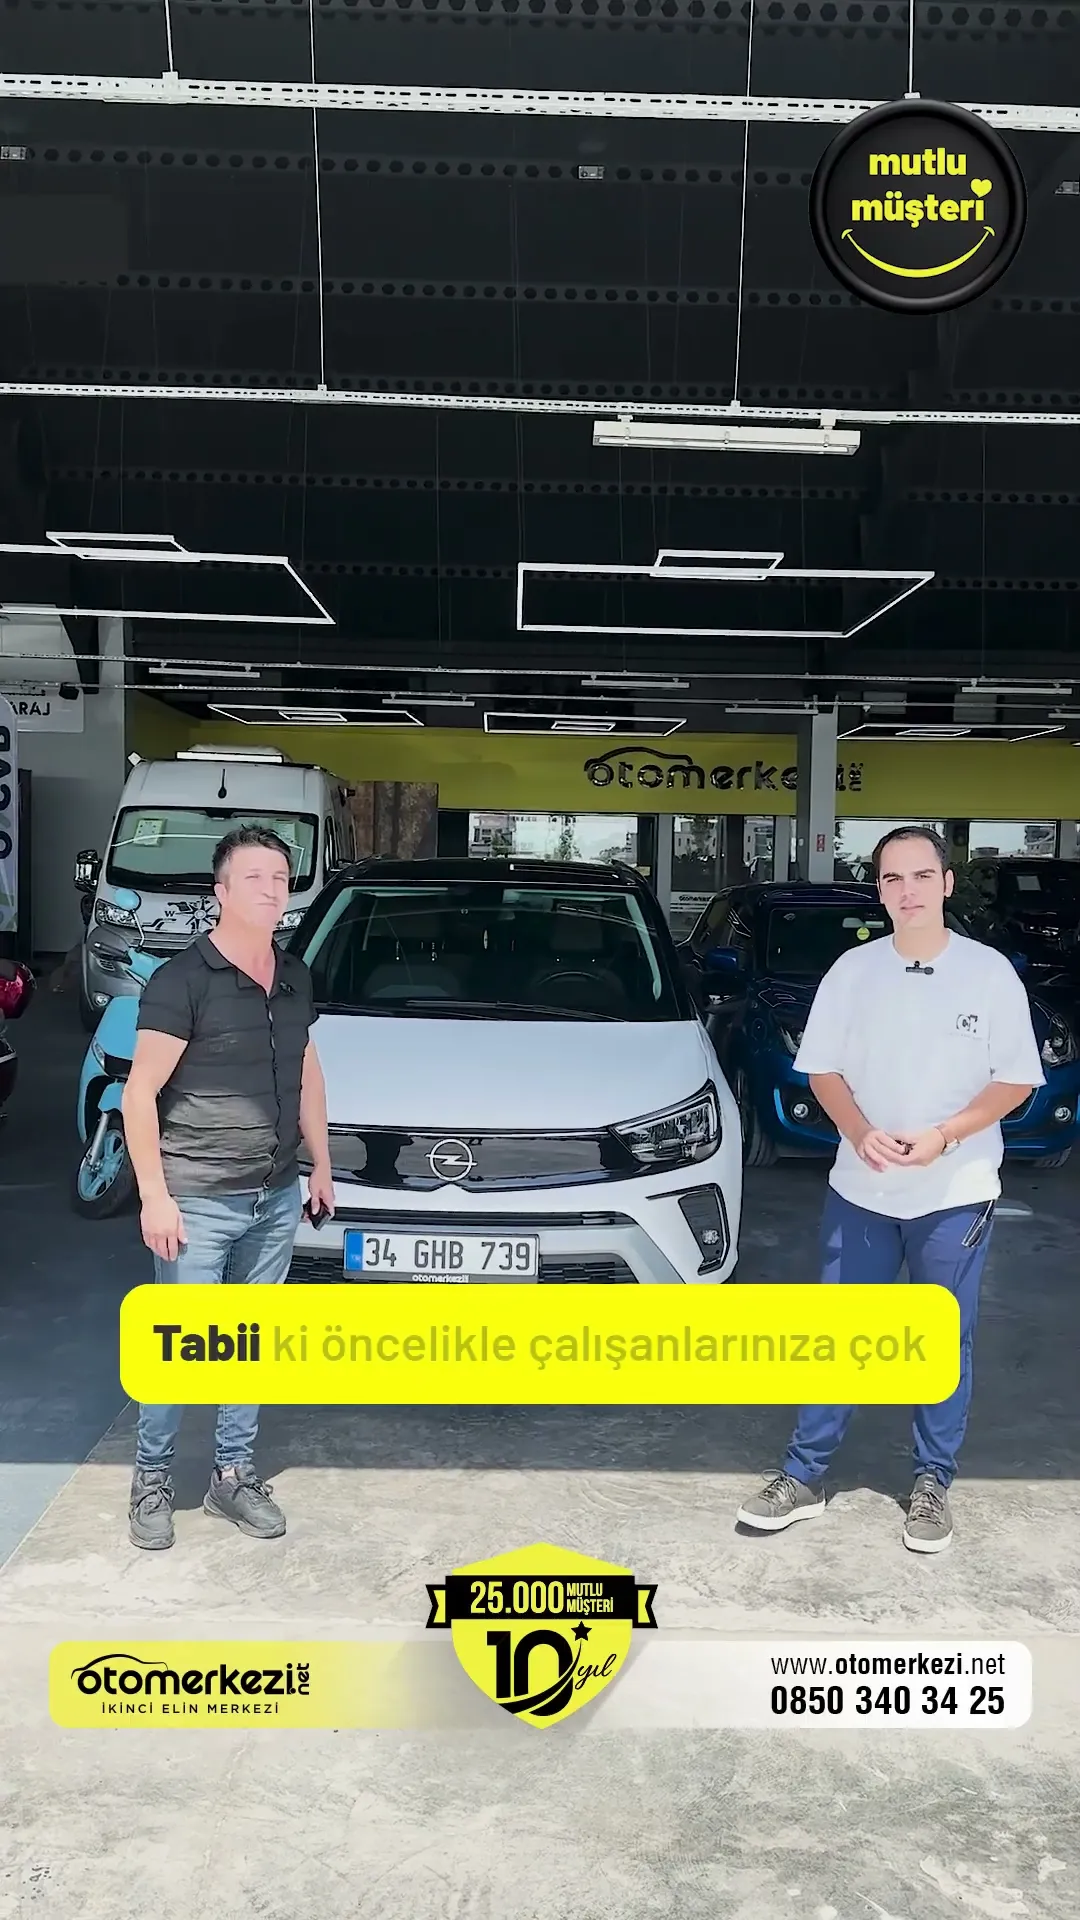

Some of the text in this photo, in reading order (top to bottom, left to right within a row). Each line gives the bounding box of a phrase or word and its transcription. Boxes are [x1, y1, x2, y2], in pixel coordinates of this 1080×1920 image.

[366, 1238, 530, 1271] 34 GHB 739
